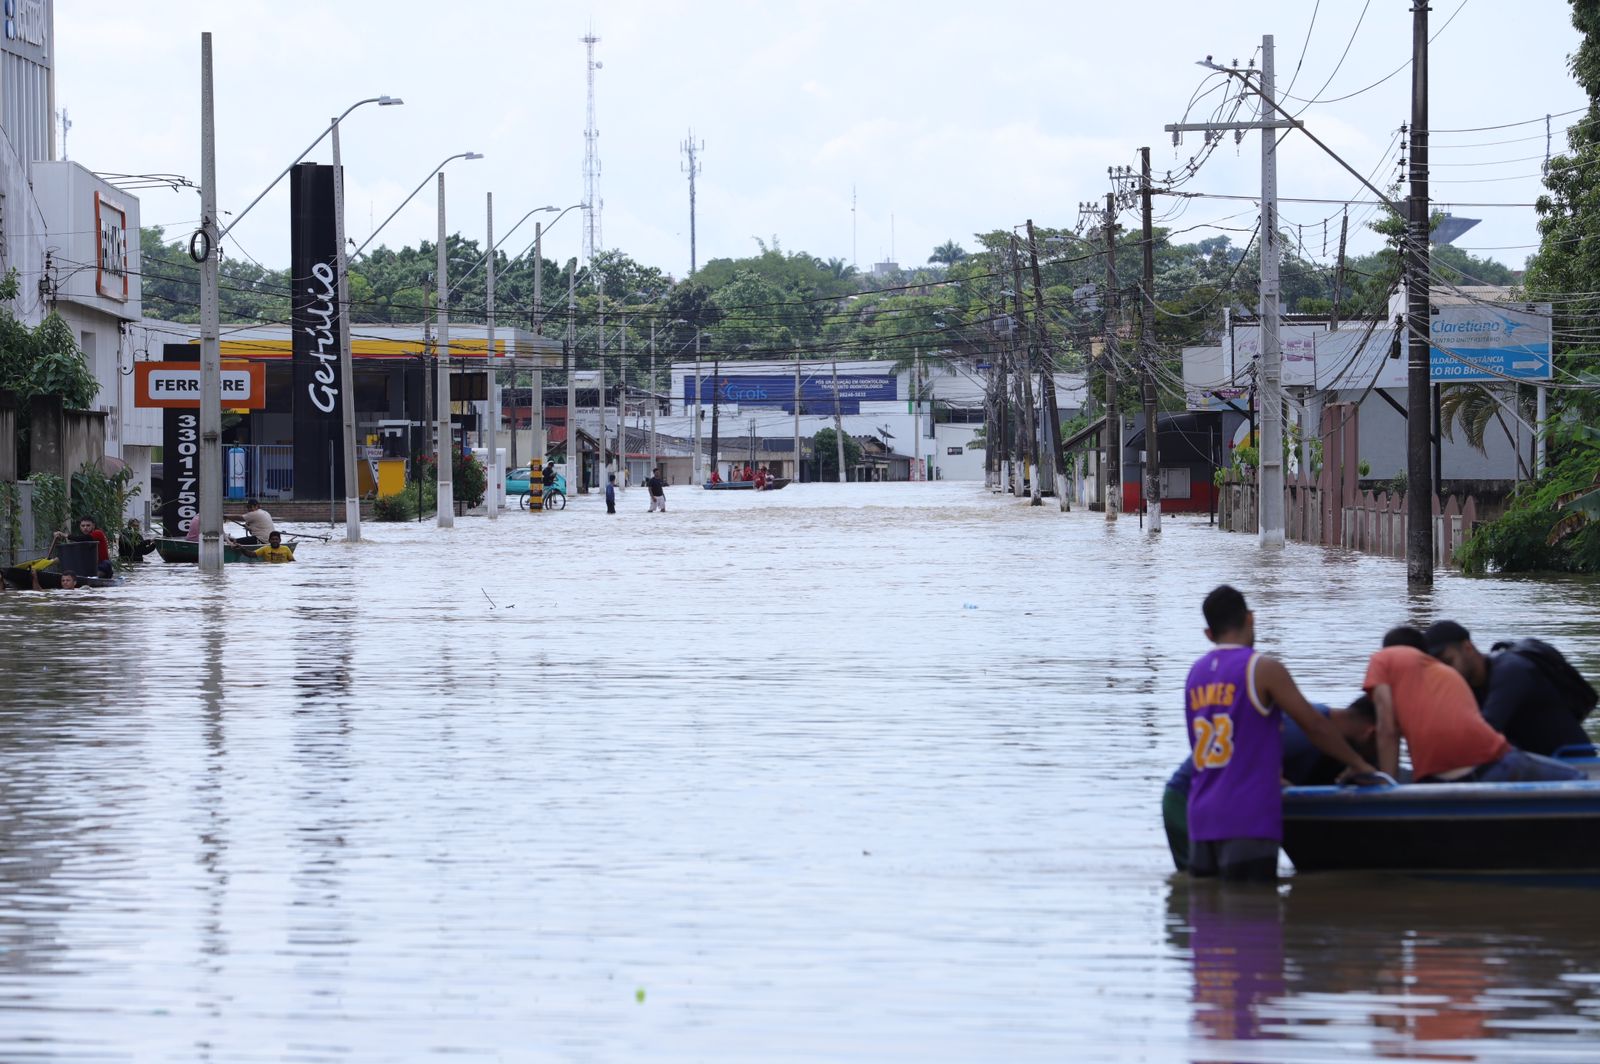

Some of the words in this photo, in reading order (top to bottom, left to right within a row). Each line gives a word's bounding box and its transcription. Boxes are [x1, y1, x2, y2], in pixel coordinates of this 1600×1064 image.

[307, 262, 338, 414] Getúlio
[1432, 319, 1499, 333] Claretiano
[1444, 366, 1462, 375] RIO
[155, 379, 245, 392] FERRRE
[177, 415, 197, 533] 3301-7566
[1190, 683, 1236, 711] JAMES
[1193, 713, 1234, 770] 23
